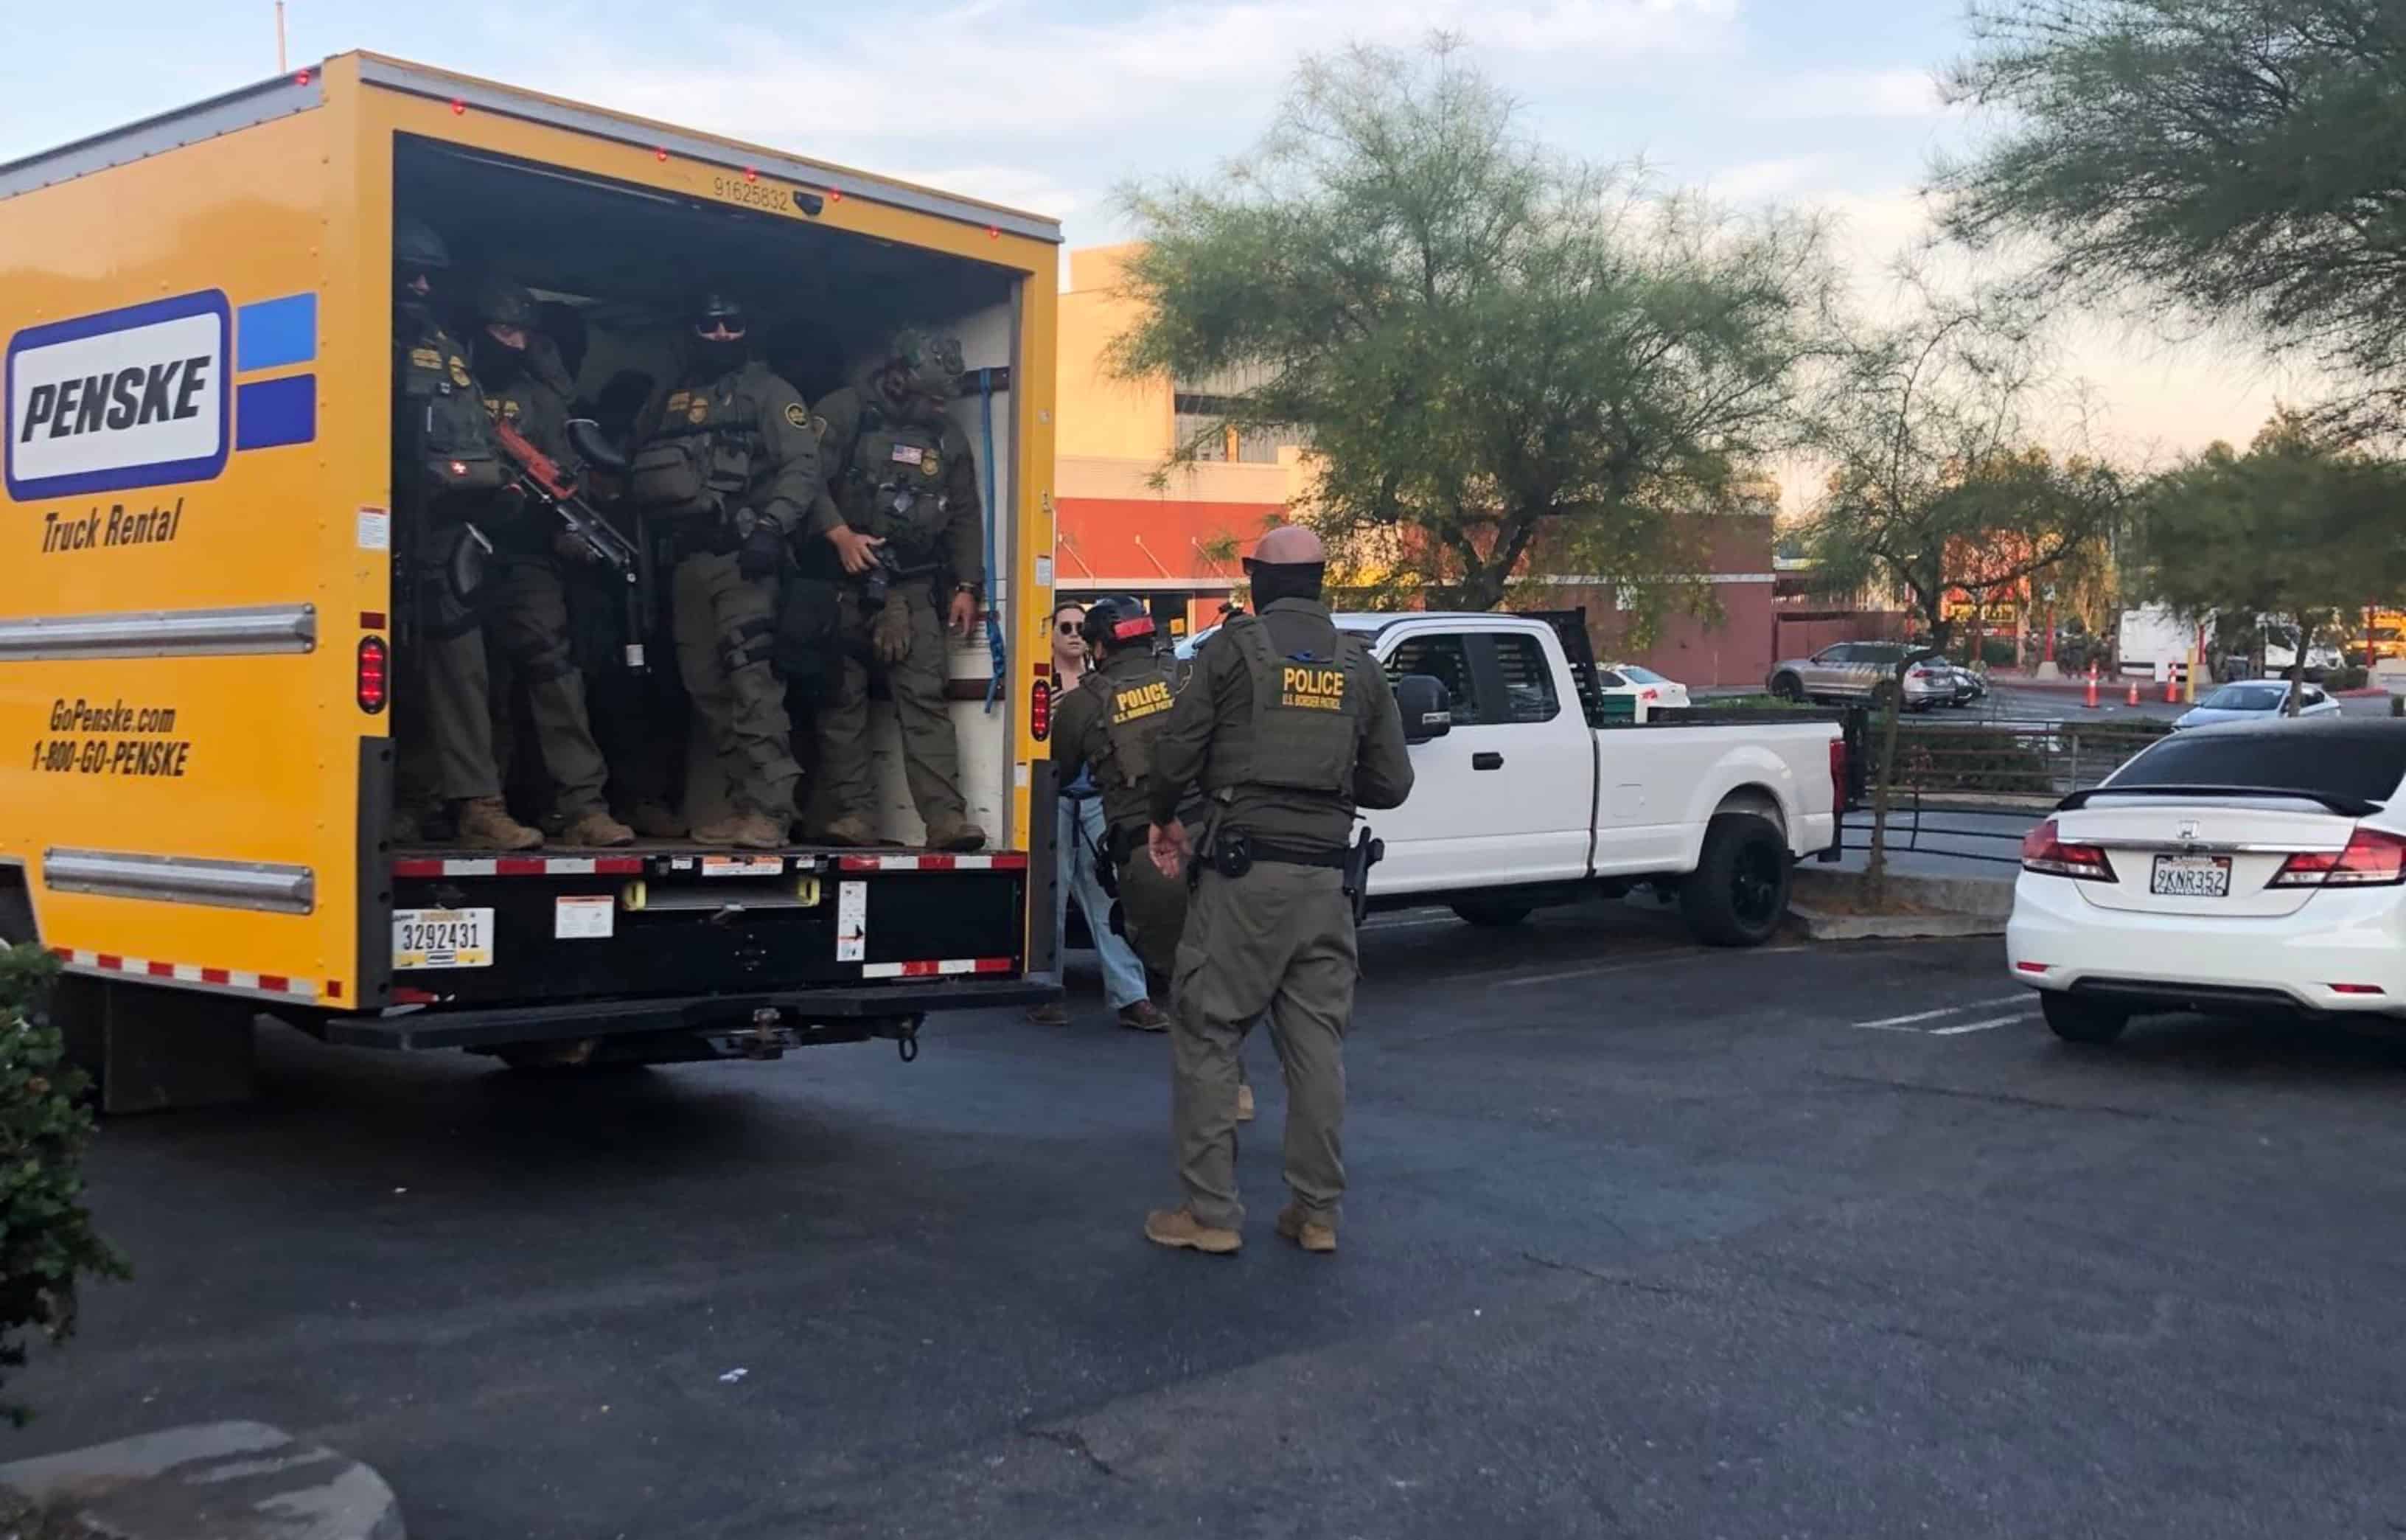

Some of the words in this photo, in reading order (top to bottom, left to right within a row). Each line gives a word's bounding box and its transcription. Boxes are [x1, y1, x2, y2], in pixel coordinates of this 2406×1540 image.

[714, 176, 788, 211] 91625832
[21, 355, 212, 443] PENSKE
[42, 508, 97, 553] Truck
[104, 498, 184, 546] Rental
[1116, 681, 1171, 711] POLICE
[1283, 667, 1345, 696] POLICE
[50, 699, 176, 733] GoPenske.com
[32, 741, 191, 776] 1-800-GO-PENSKE
[2157, 869, 2225, 891] 9KNR352
[402, 923, 479, 950] 3292431
